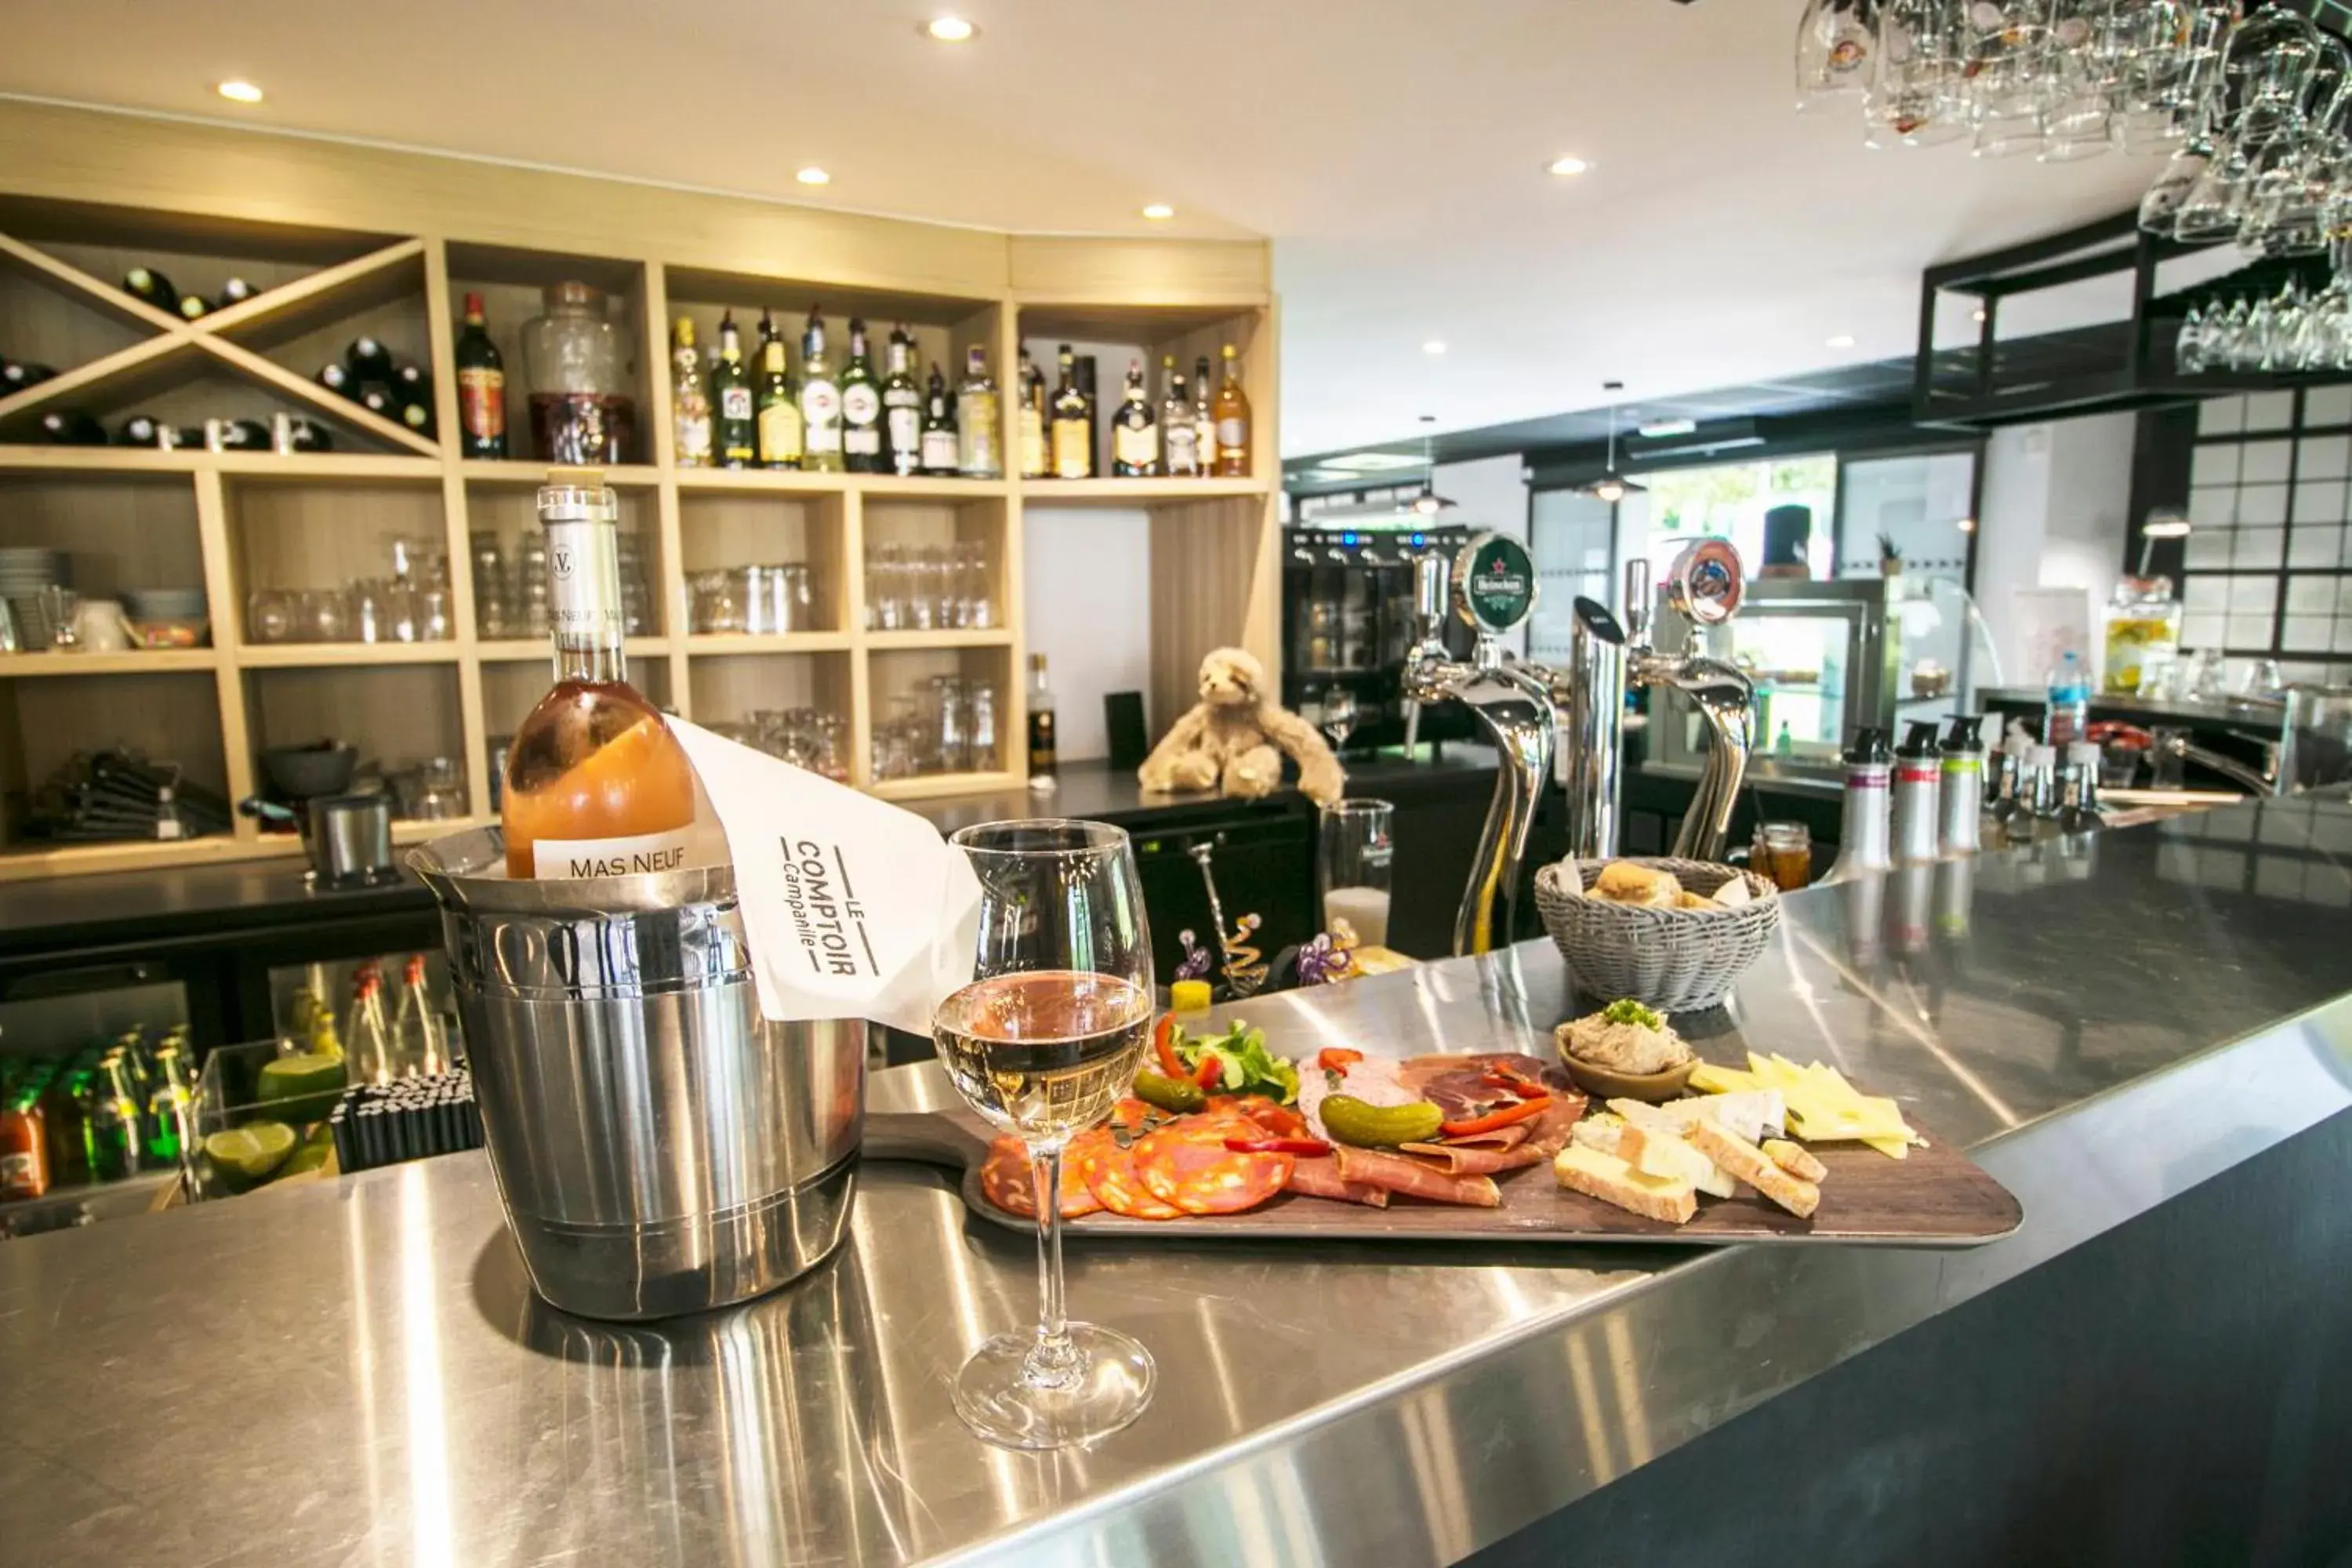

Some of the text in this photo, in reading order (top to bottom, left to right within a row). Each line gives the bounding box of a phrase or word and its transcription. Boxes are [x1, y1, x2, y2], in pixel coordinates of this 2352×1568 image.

[570, 846, 684, 877] MAS NEUF
[783, 862, 816, 947] Campanile
[797, 840, 857, 976] COMPTOIR
[844, 901, 865, 919] LE
